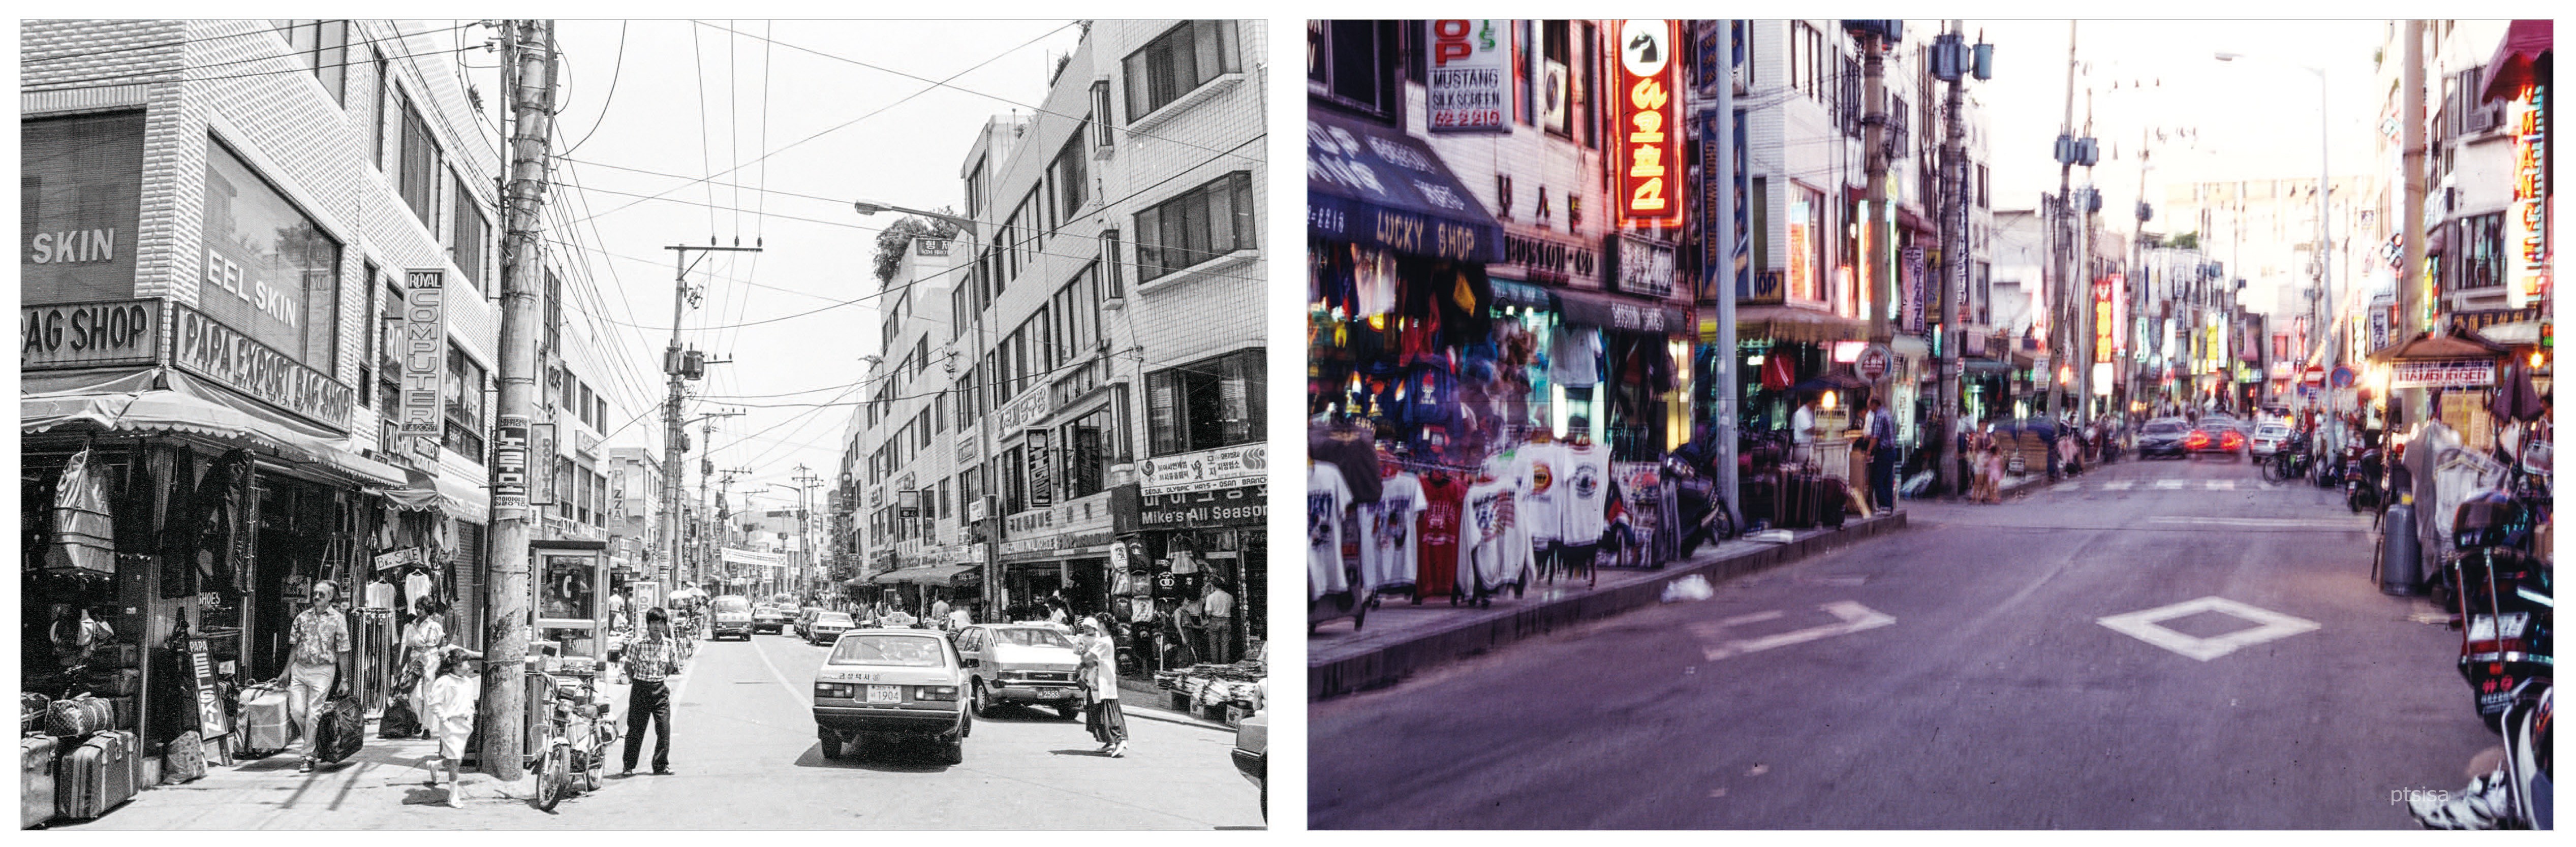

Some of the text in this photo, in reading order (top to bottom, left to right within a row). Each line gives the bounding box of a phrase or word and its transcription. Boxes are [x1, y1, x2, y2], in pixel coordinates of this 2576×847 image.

[1434, 69, 1498, 89] MUSTANG
[1433, 90, 1500, 110] SILK SCREEN
[1376, 209, 1474, 261] LUCKY SHOP
[32, 228, 115, 264] SKIN
[207, 247, 296, 328] EEL SKIN
[409, 273, 442, 288] ROYAL
[21, 304, 149, 355] AG SHOP
[405, 290, 440, 423] COMPUTER
[183, 311, 231, 373] PAPA
[233, 336, 292, 396] EXPORT
[295, 365, 319, 412] BAG
[320, 379, 351, 423] SHOP
[2398, 367, 2488, 384] HAMBURGER
[613, 469, 623, 519] PZZA
[1142, 510, 1184, 524] Mike's
[1190, 508, 1208, 521] All
[395, 549, 419, 564] SALE
[198, 591, 221, 605] SHOES
[190, 640, 208, 653] PAPA
[878, 691, 899, 701] 1904
